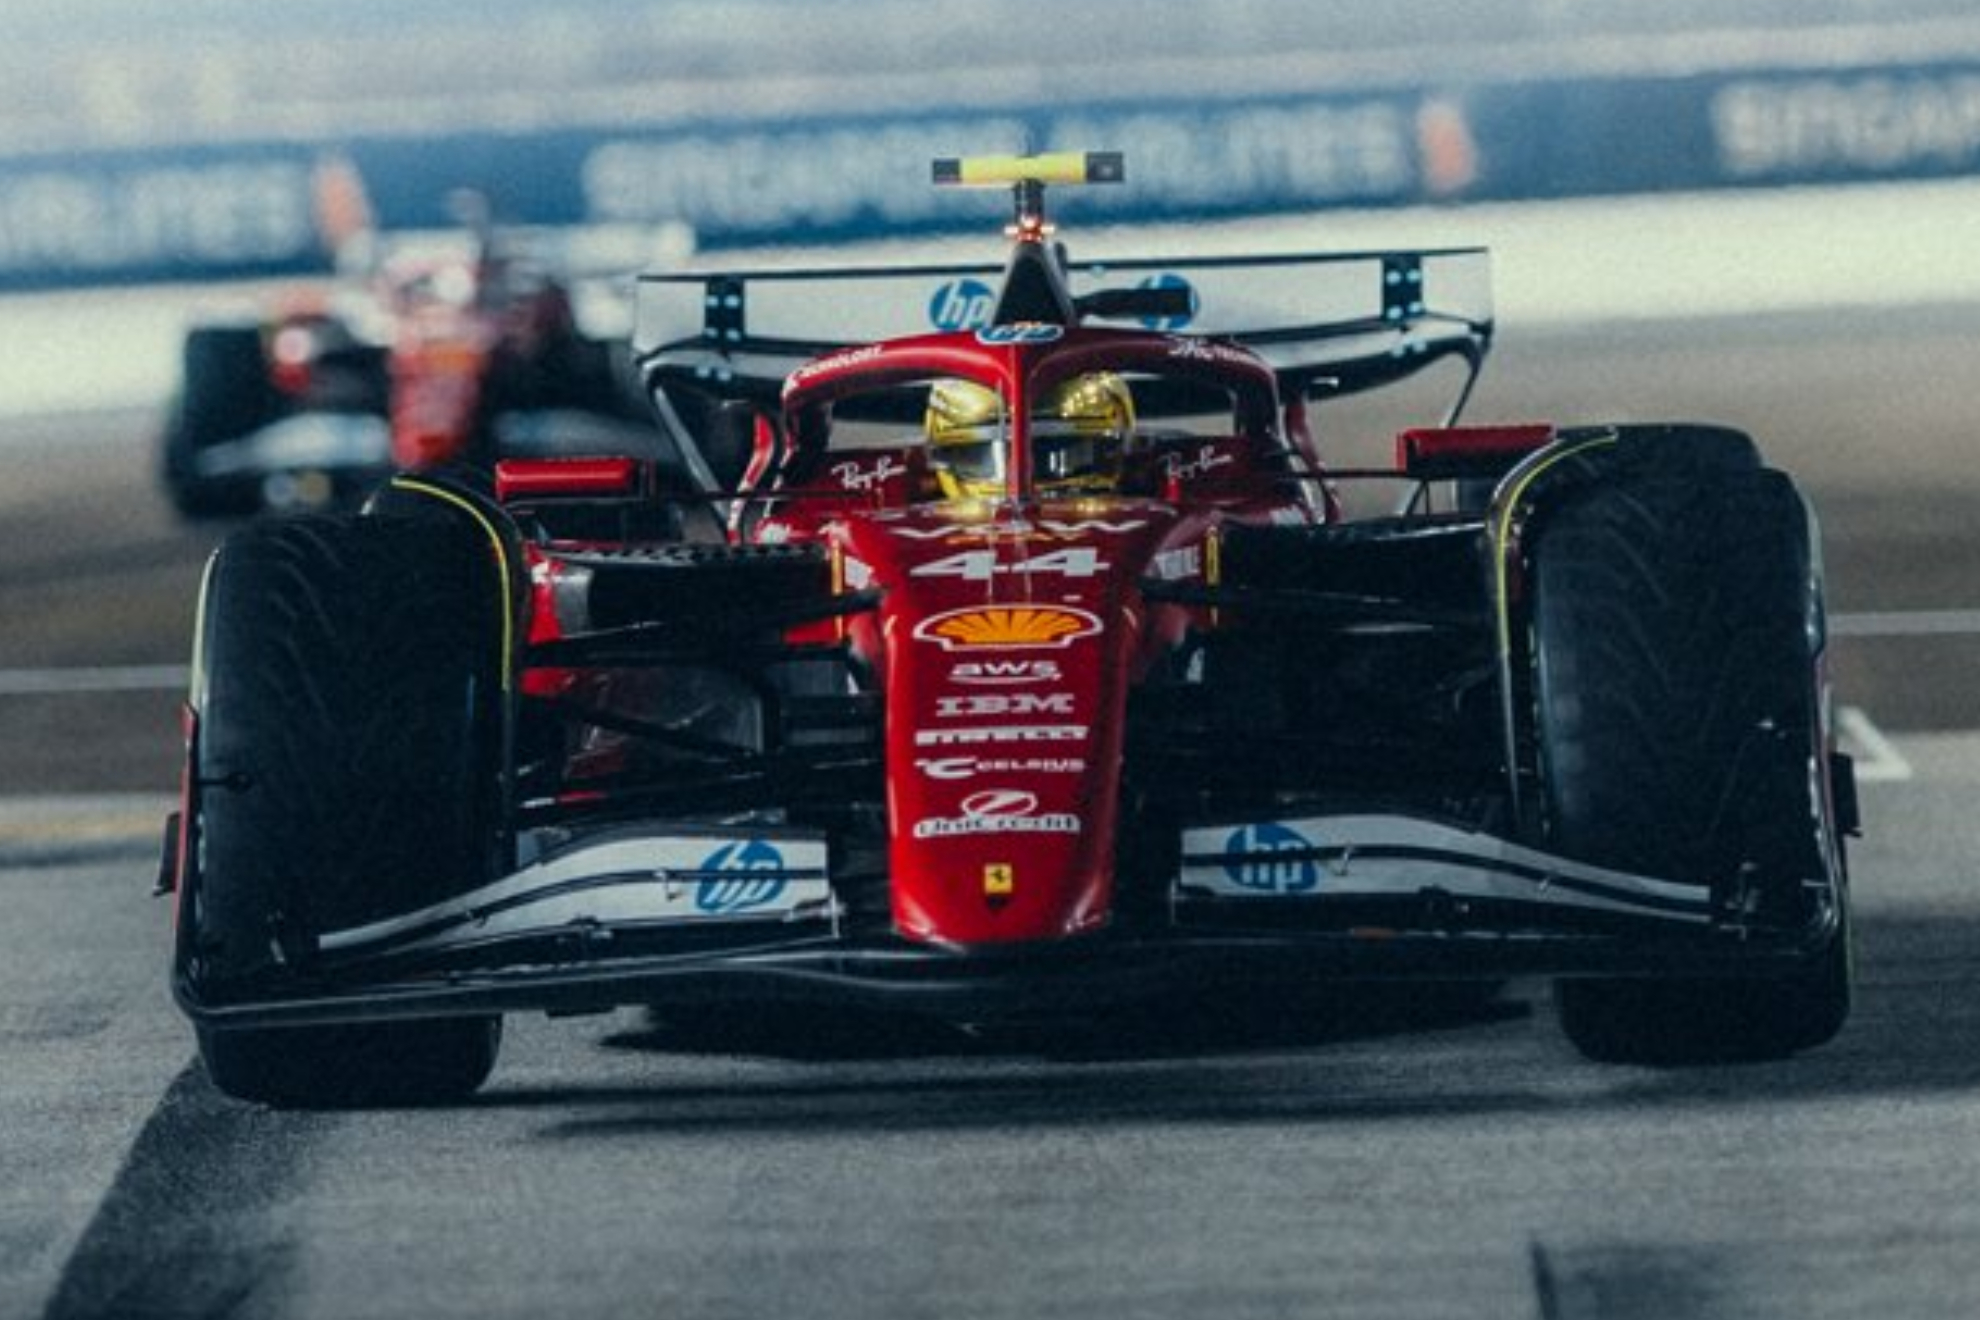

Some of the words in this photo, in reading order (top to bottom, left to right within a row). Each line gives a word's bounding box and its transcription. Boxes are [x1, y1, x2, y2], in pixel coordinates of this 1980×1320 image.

[909, 547, 1110, 580] 44
[951, 660, 1060, 677] aws
[935, 693, 1076, 717] IBM
[1239, 823, 1309, 893] hp
[703, 839, 780, 913] hp
